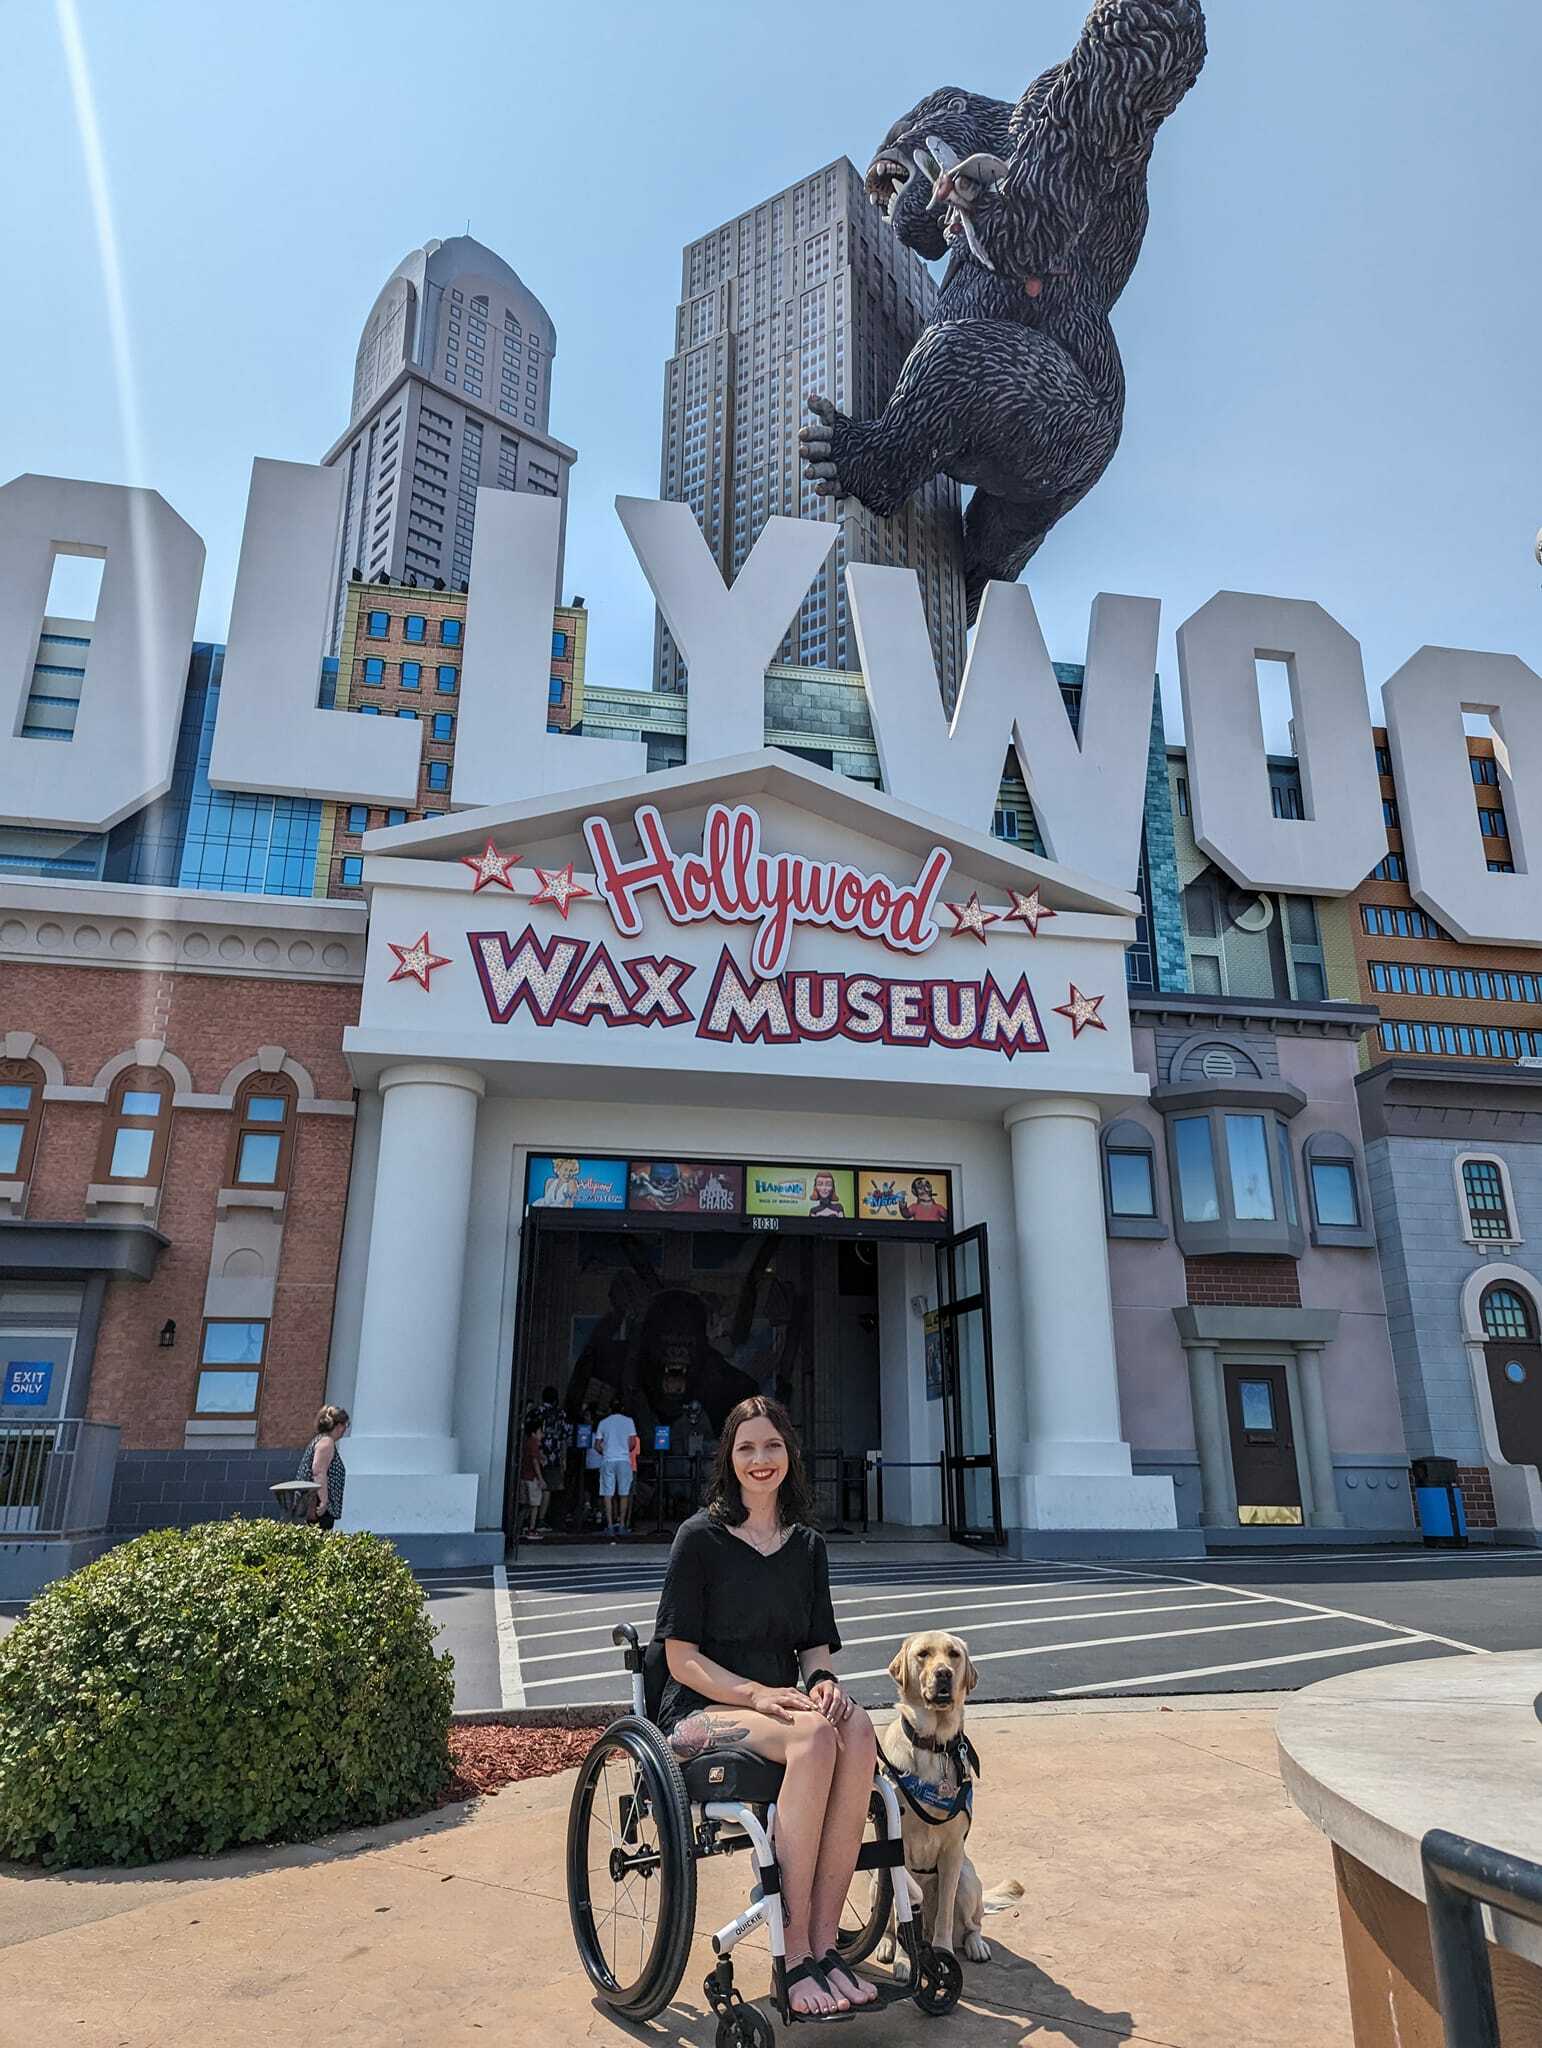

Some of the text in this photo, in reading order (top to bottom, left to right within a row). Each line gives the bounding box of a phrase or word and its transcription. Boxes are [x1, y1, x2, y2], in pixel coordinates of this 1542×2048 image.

[583, 803, 952, 980] Hollywood
[466, 923, 1050, 1062] WAX MUSEUM
[699, 1197, 734, 1210] CHAOS
[752, 1217, 779, 1230] 3030
[13, 1371, 46, 1383] EXIT
[11, 1384, 43, 1393] ONLY
[735, 1911, 763, 1936] QUICKIE
